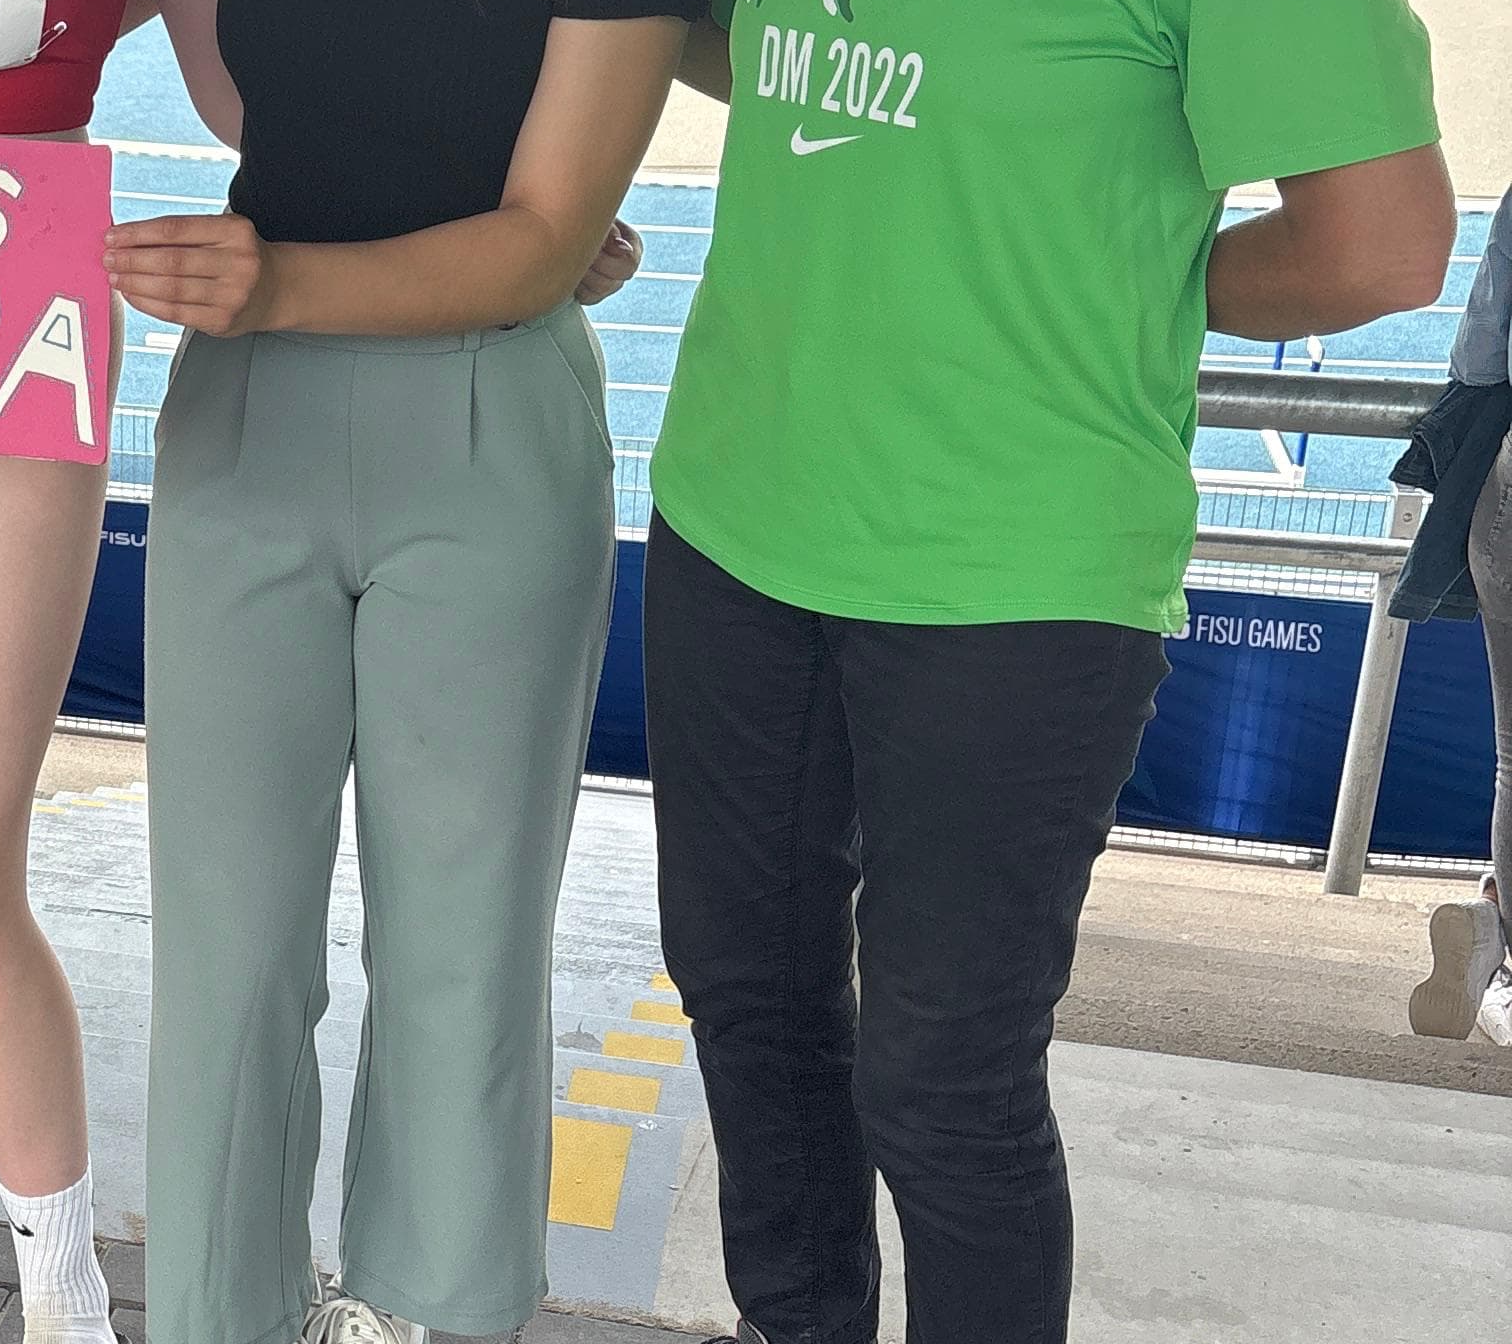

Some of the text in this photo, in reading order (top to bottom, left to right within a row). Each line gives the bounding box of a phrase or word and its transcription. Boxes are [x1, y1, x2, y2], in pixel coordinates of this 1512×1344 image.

[757, 25, 924, 128] DM 2022
[1196, 614, 1242, 645] FISU
[1248, 619, 1323, 653] GAMES
